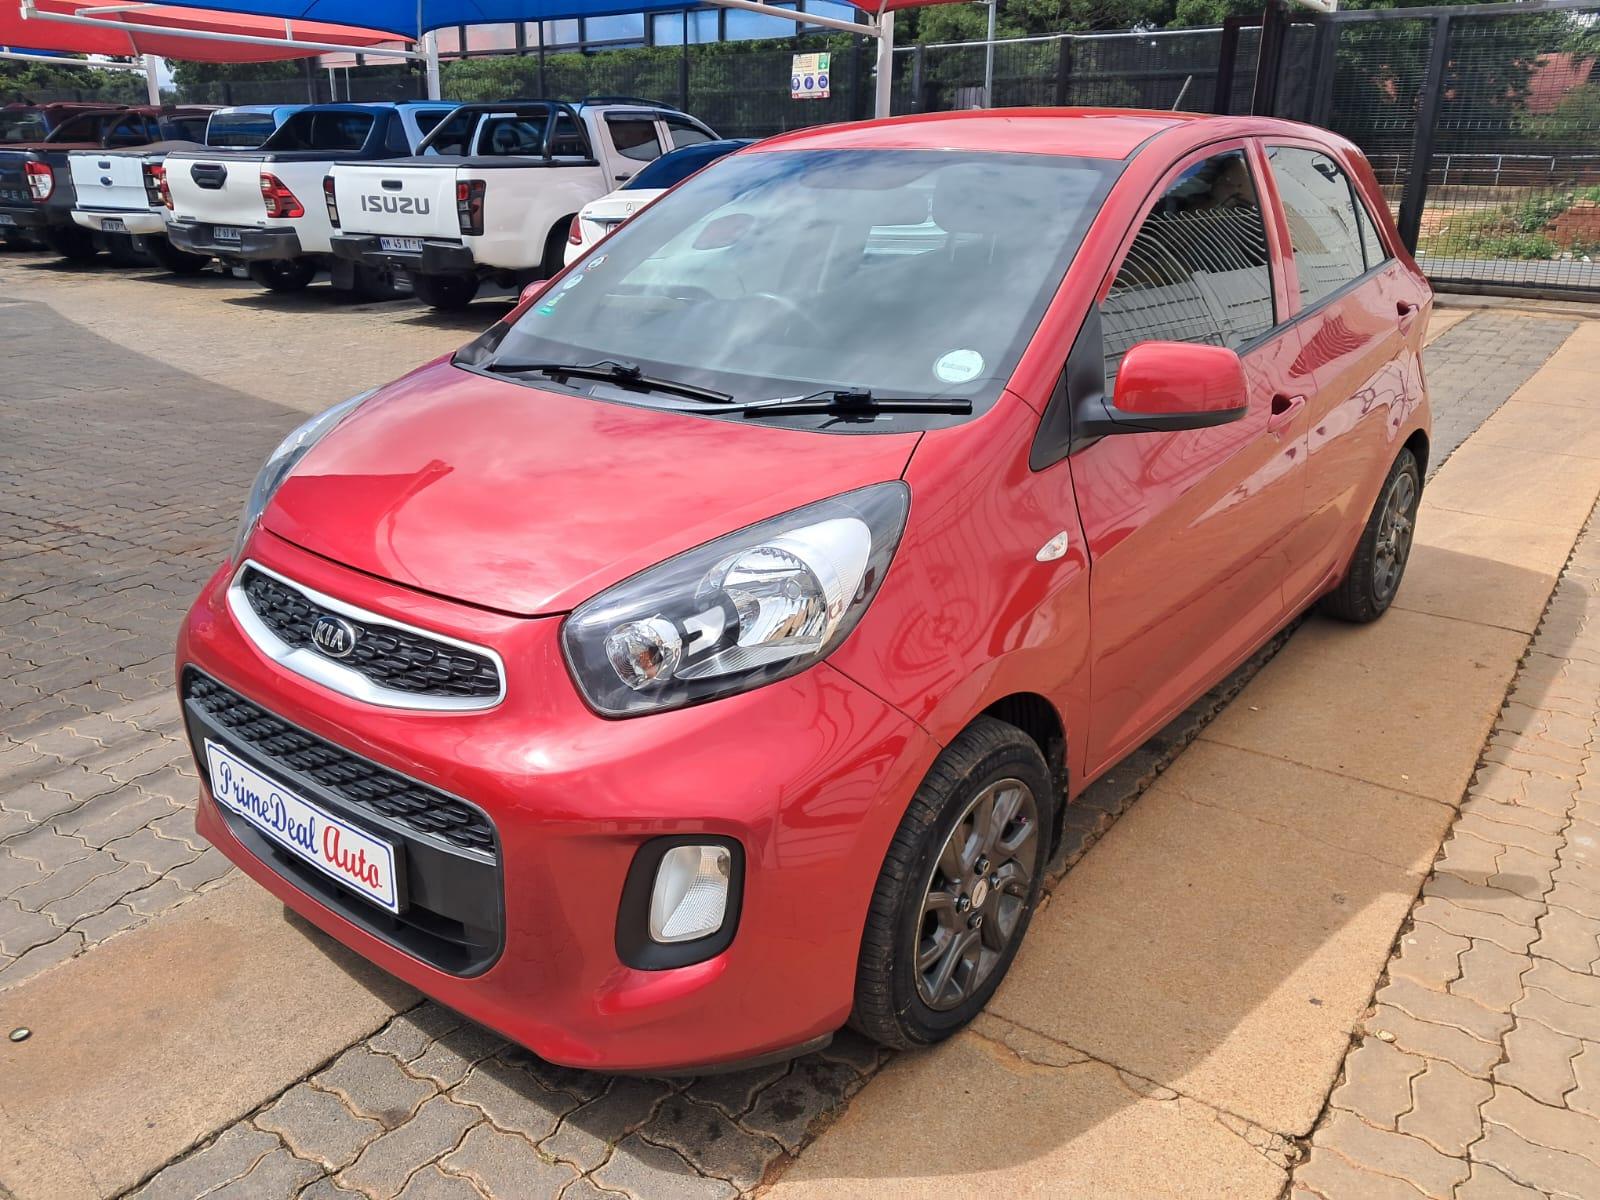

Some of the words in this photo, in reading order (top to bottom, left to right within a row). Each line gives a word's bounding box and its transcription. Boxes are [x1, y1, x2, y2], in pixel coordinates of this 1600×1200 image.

[361, 195, 430, 215] ISUZU
[314, 620, 344, 651] KIA
[219, 760, 319, 855] PrimeDeal
[322, 824, 383, 889] Auto
